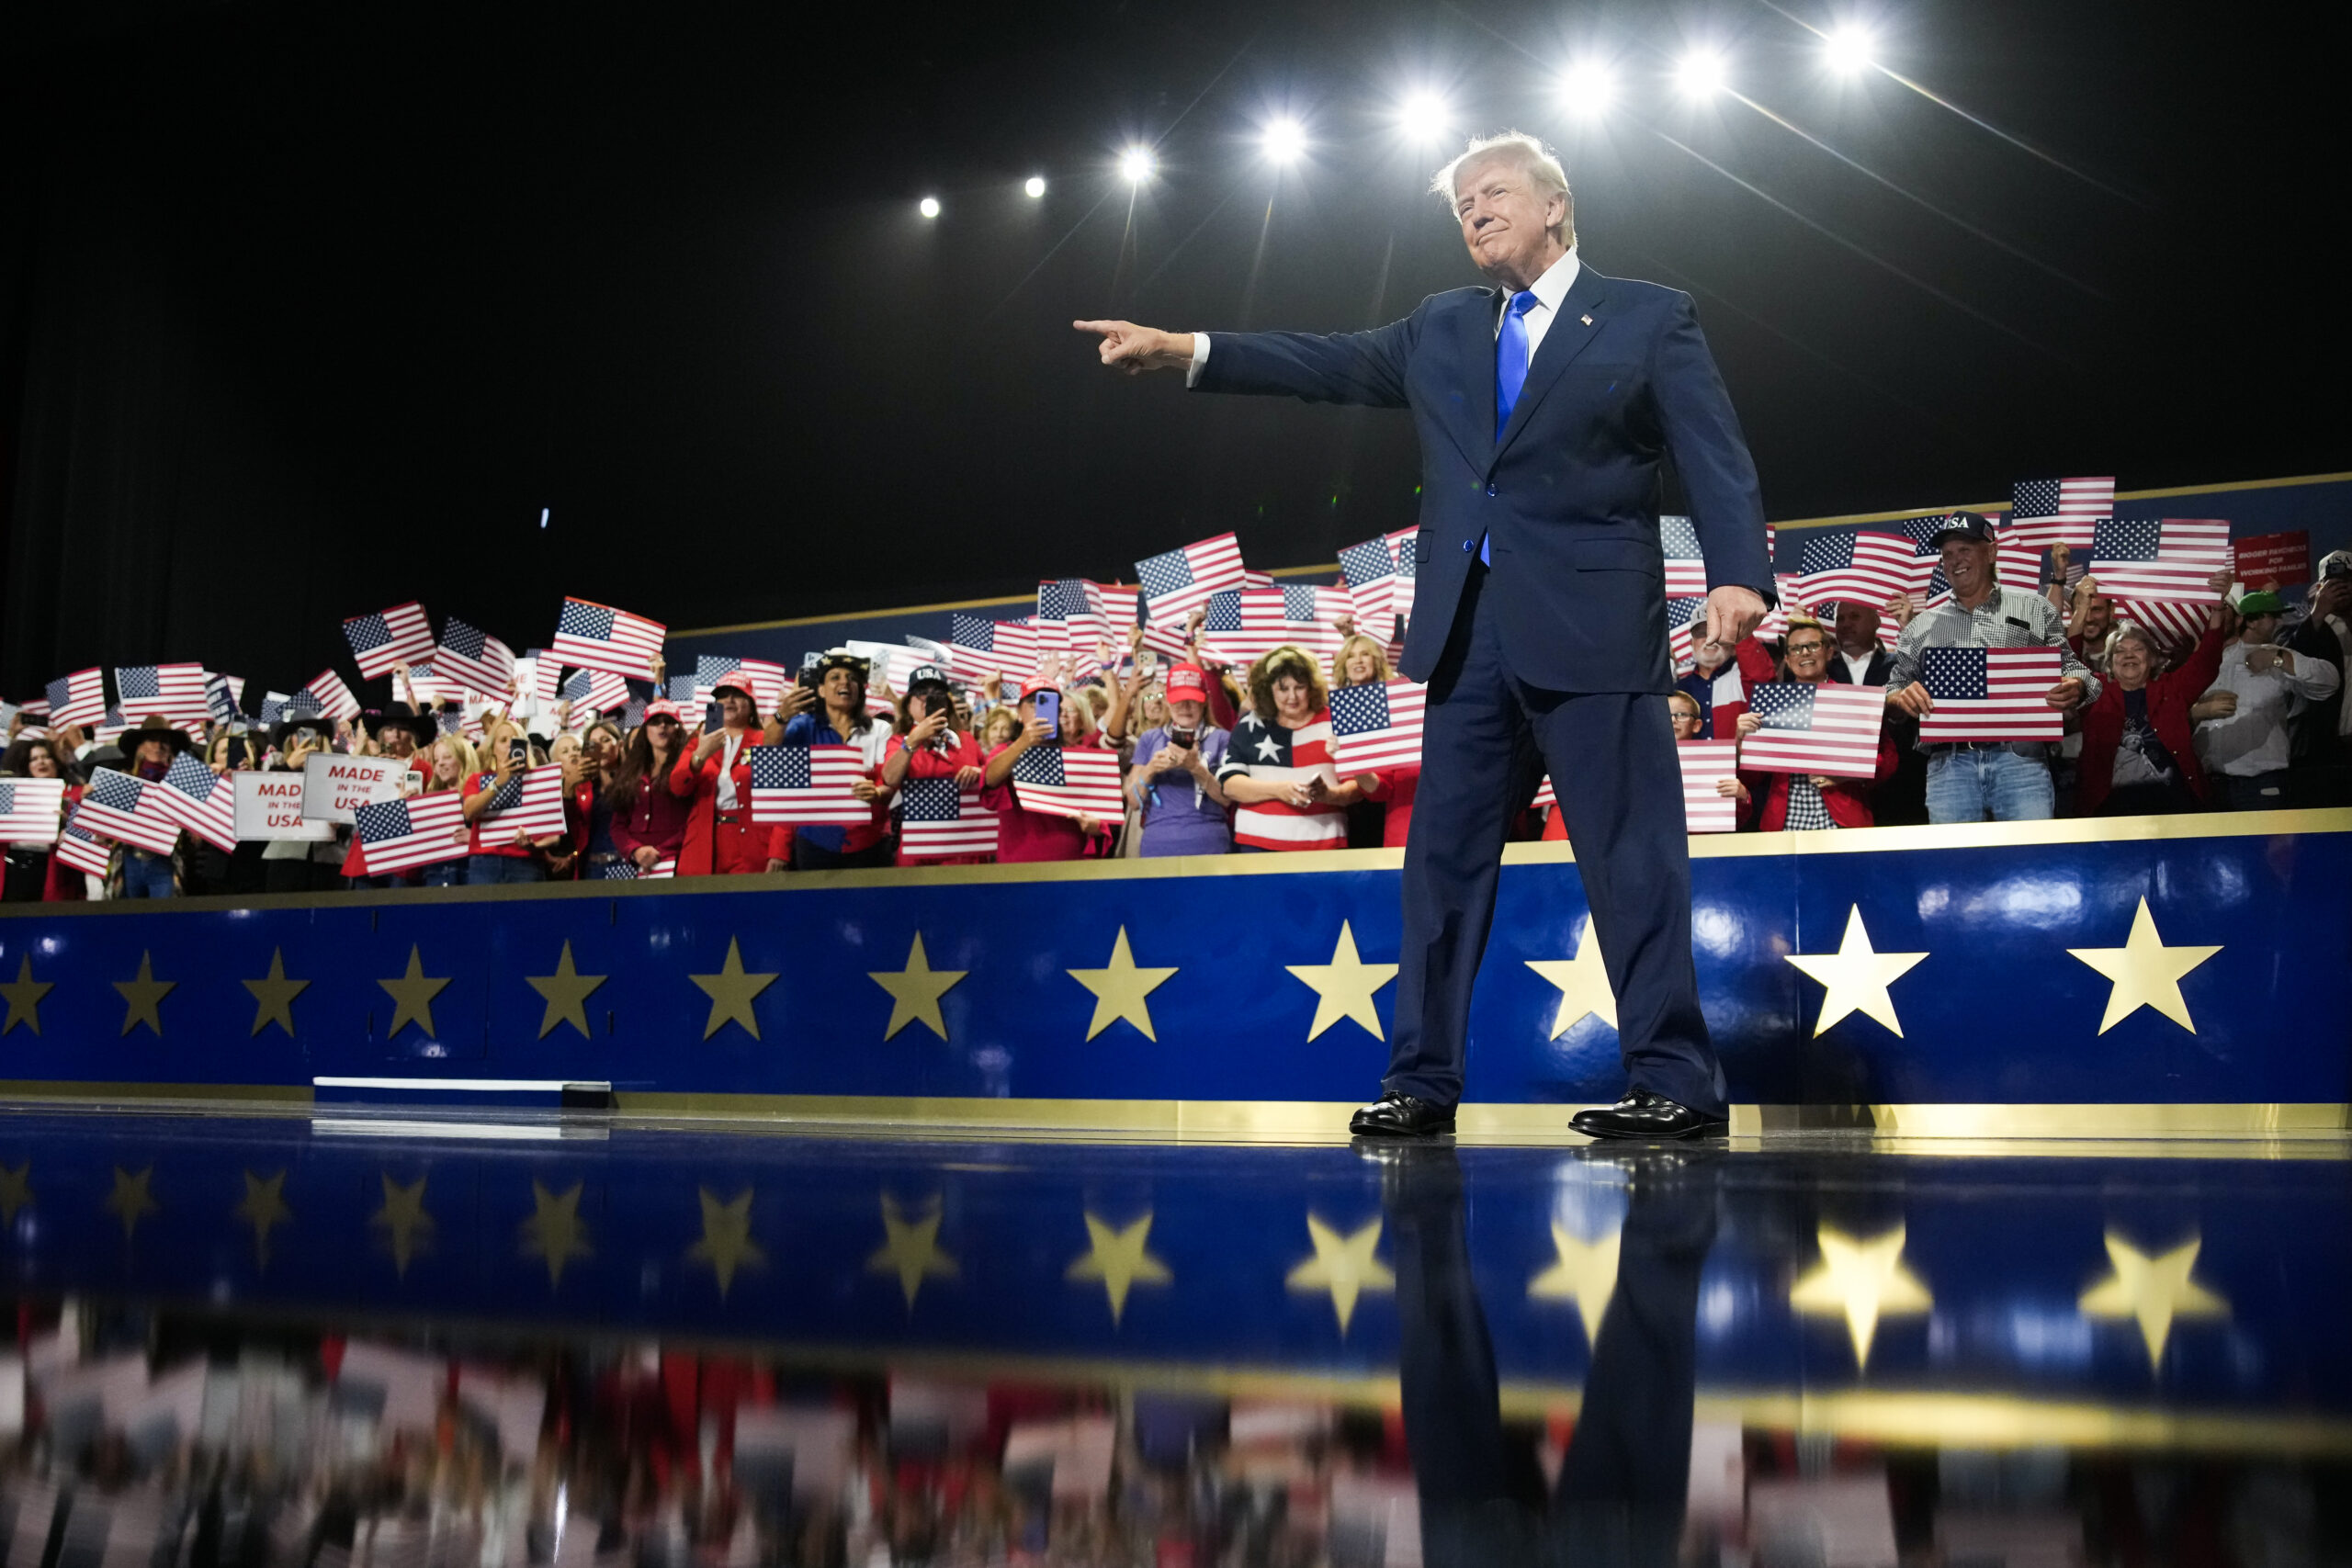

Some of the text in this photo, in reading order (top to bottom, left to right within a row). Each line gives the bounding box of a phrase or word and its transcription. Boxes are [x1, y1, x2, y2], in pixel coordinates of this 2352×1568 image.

[1943, 516, 1970, 530] USA
[2240, 567, 2278, 577] WORKING
[916, 668, 941, 680] USA
[328, 765, 385, 782] MADE
[258, 784, 301, 797] MAD
[337, 784, 372, 794] IN THE
[267, 801, 279, 809] IN
[266, 815, 303, 828] USA
